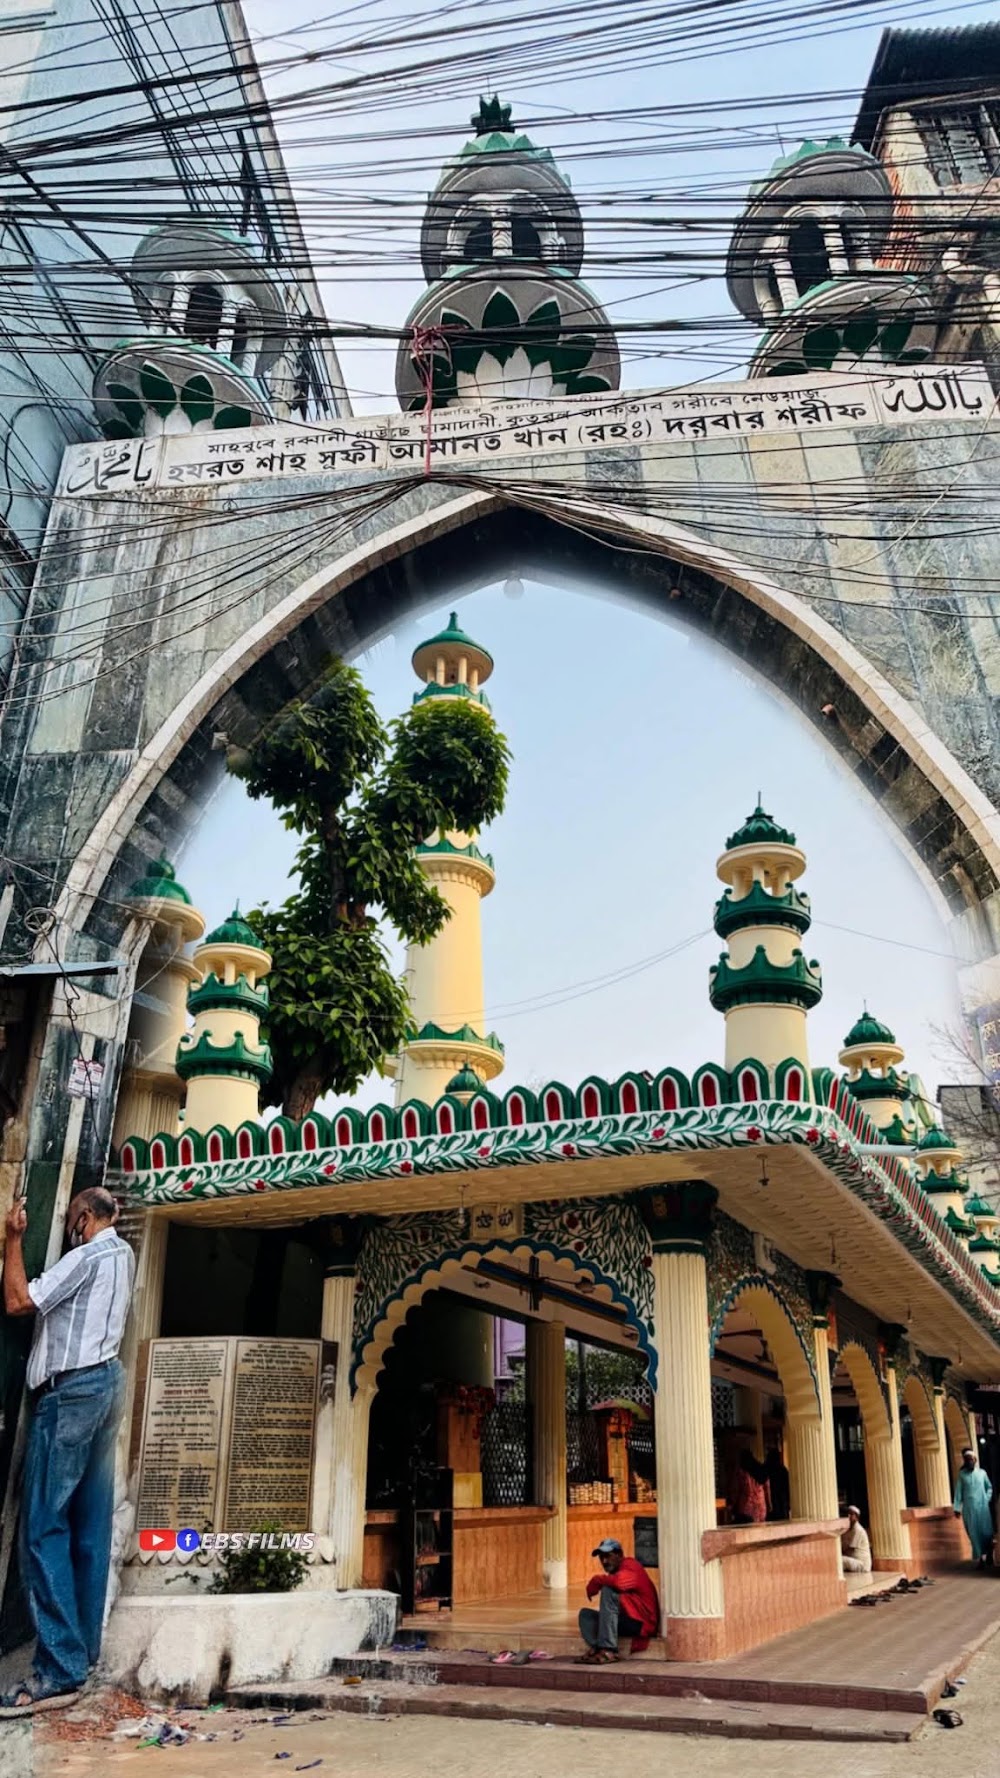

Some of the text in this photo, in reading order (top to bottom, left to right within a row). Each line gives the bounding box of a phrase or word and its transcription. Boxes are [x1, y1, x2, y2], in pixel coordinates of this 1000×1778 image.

[672, 394, 732, 410] গরীবে
[168, 459, 245, 482] হযরত
[318, 440, 380, 471] সূফী
[389, 434, 501, 459] আমানত
[514, 426, 568, 448] খান
[775, 399, 867, 425] শরীফ
